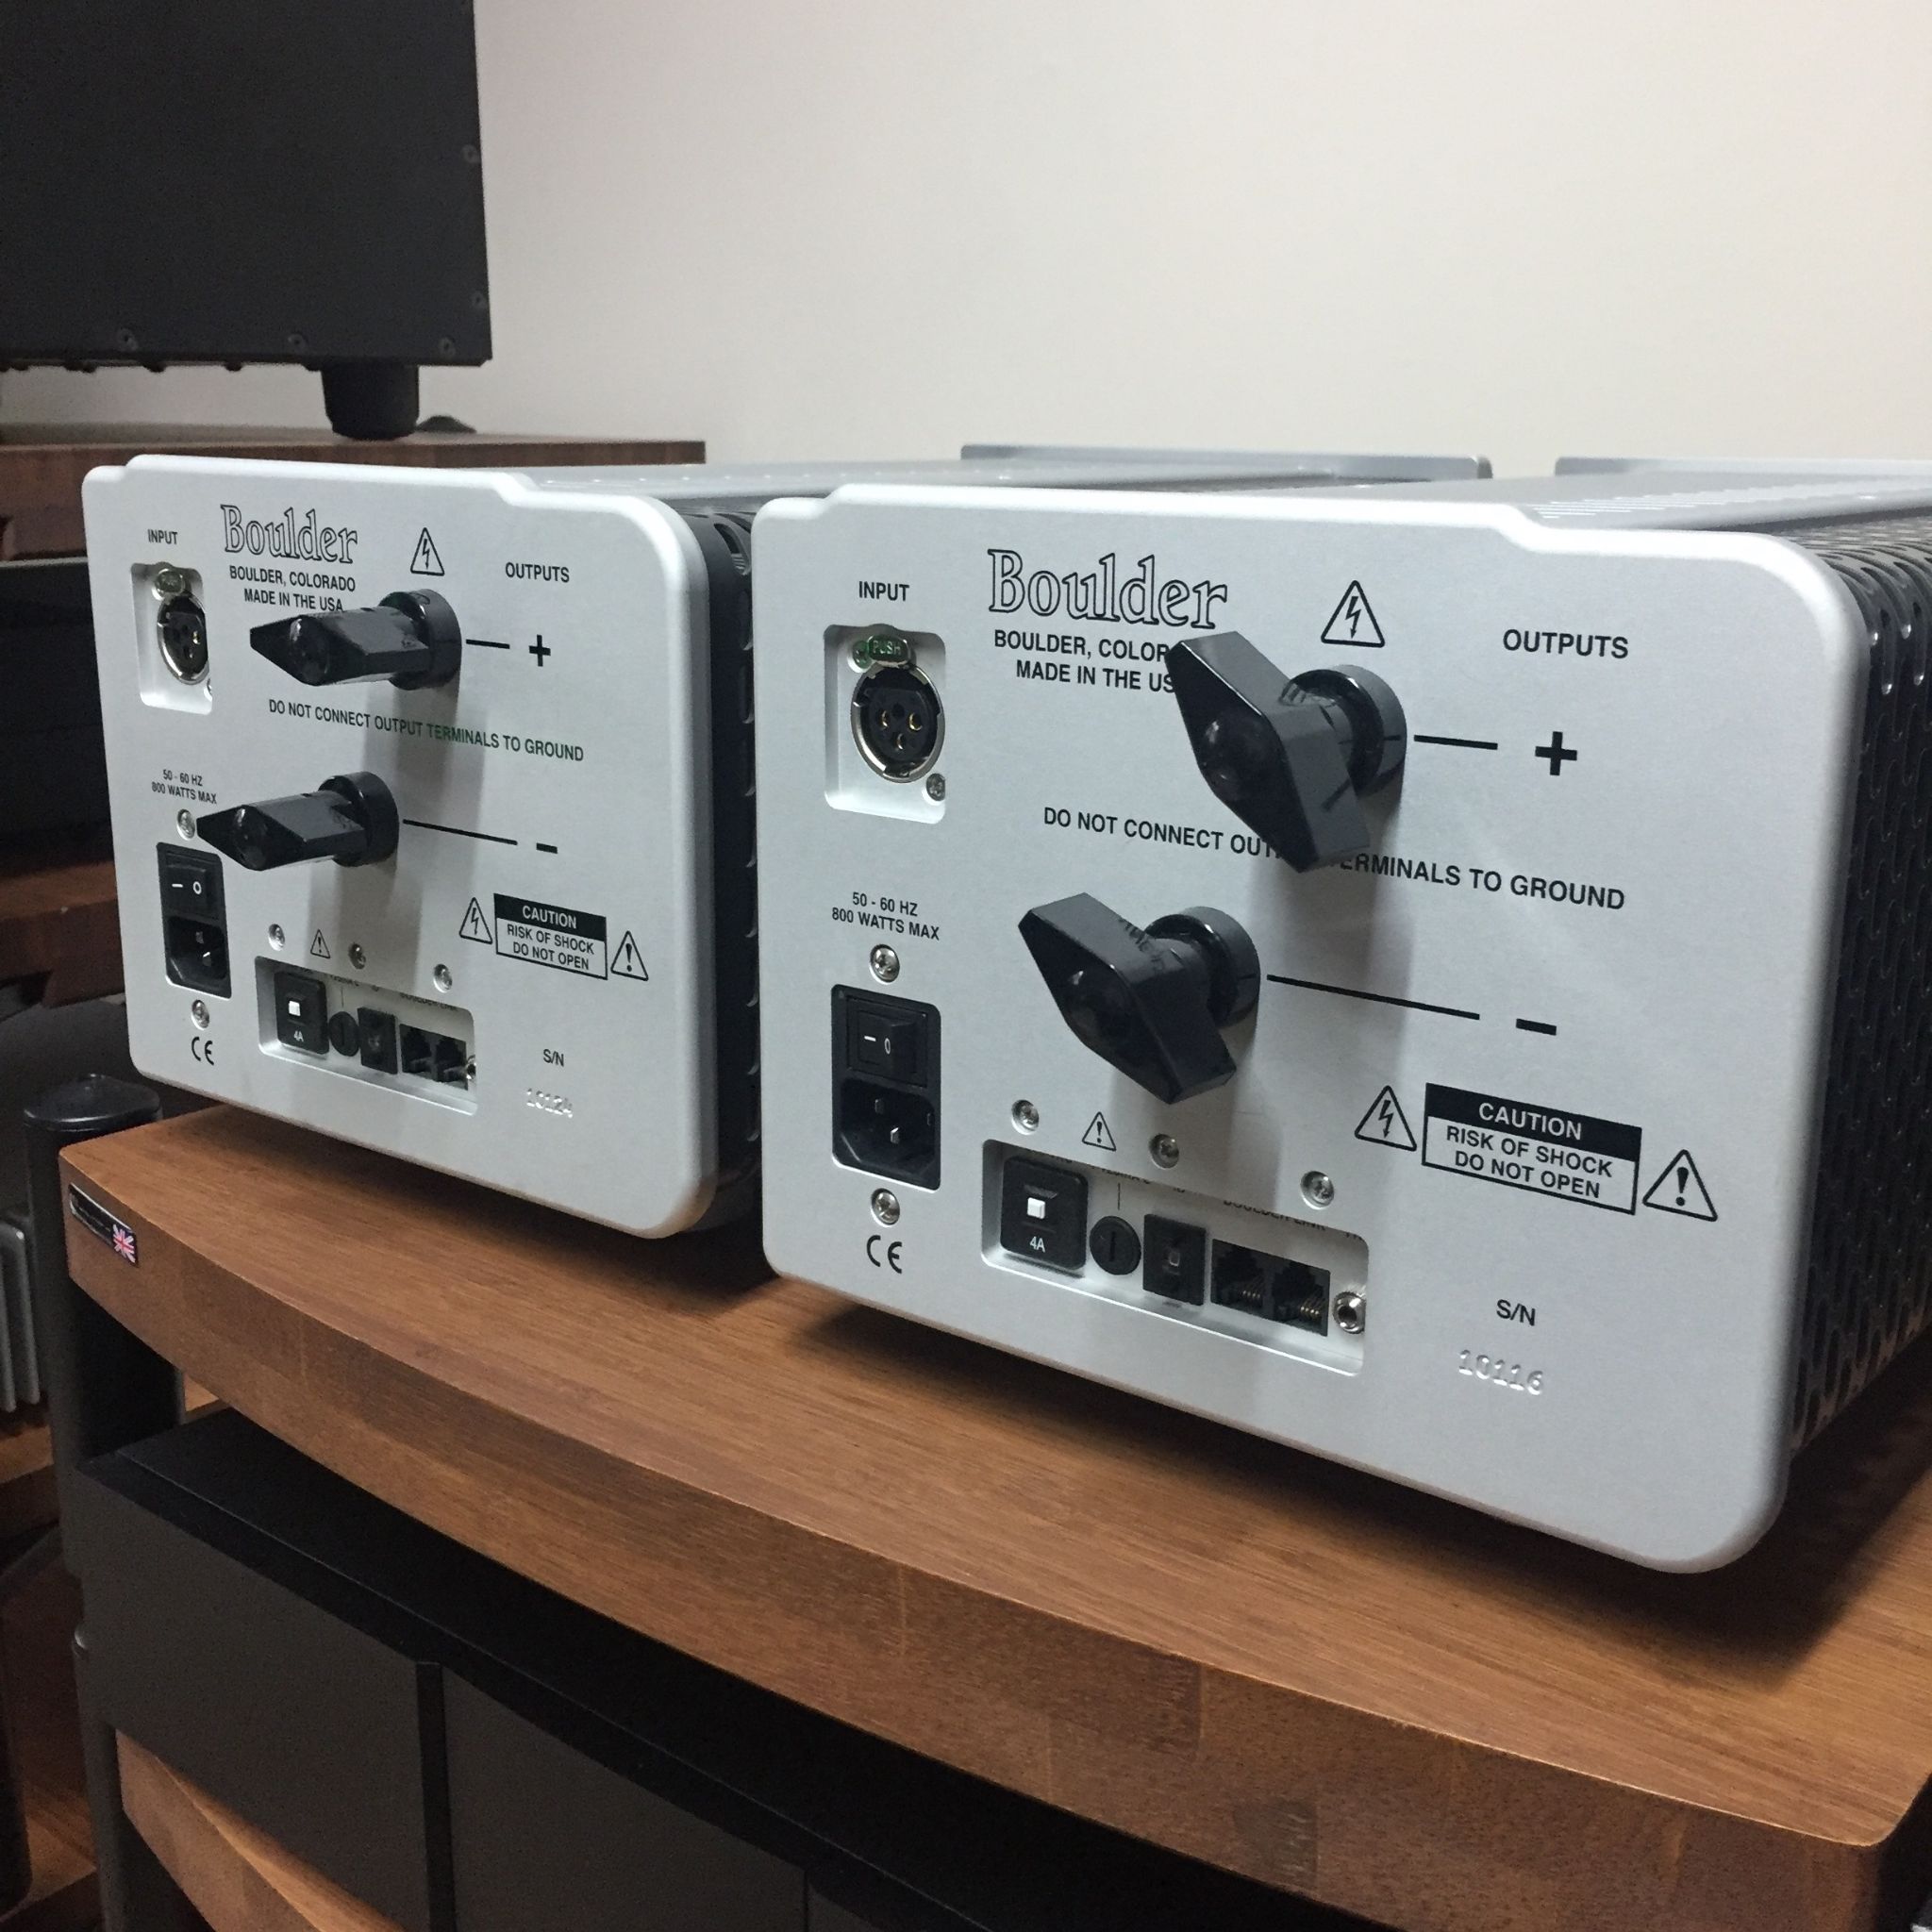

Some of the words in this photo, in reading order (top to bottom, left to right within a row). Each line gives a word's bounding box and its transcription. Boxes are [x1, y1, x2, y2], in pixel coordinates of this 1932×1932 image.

[147, 529, 178, 545] INPUT
[221, 504, 358, 564] Boulder
[229, 565, 287, 587] BOULDER,
[289, 572, 356, 591] COLORADO
[506, 561, 570, 583] OUTPUTS
[243, 589, 275, 605] MADE
[279, 593, 291, 607] IN
[293, 593, 316, 609] THE
[319, 597, 343, 612] USA
[858, 581, 910, 602] INPUT
[988, 548, 1227, 629] Boulder
[994, 629, 1091, 659] BOULDER,
[1098, 639, 1170, 662] COLOR
[1503, 629, 1629, 658] OUTPUTS
[1016, 660, 1071, 682] MADE
[1077, 666, 1095, 685] IN
[1103, 668, 1141, 690] THE
[1149, 673, 1176, 693] US
[269, 699, 285, 714] DO
[289, 702, 311, 718] NOT
[315, 707, 370, 728] CONNECT
[375, 716, 423, 737] OUTPUT
[426, 724, 500, 748] TERMINALS
[503, 735, 521, 752] TO
[525, 739, 584, 761] GROUND
[162, 769, 173, 781] 50
[179, 773, 190, 784] 60
[192, 774, 203, 787] HZ
[152, 781, 166, 794] 800
[168, 784, 196, 800] WATTS
[198, 791, 217, 805] MAX
[1043, 807, 1071, 827] DO
[1078, 812, 1118, 834] NOT
[1124, 819, 1224, 850] CONNECT
[1469, 868, 1502, 891] TO
[1510, 874, 1624, 910] GROUND
[522, 905, 577, 929] CAUTION
[852, 891, 867, 907] 50
[880, 897, 895, 912] 60
[900, 901, 918, 917] HZ
[832, 907, 854, 924] 800
[858, 911, 905, 934] WATTS
[908, 922, 940, 941] MAX
[507, 924, 533, 941] RISK
[536, 930, 551, 944] OF
[554, 934, 594, 955] SHOCK
[513, 941, 529, 956] DO
[532, 946, 555, 961] NOT
[558, 954, 590, 970] OPEN
[192, 1036, 214, 1066] CE
[543, 1048, 564, 1067] S/N
[1478, 1102, 1582, 1141] CAUTION
[1446, 1125, 1494, 1151] RISK
[1501, 1138, 1529, 1158] OF
[1536, 1145, 1613, 1178] SHOCK
[1455, 1150, 1484, 1171] DO
[1491, 1158, 1534, 1183] NOT
[1541, 1170, 1600, 1198] OPEN
[866, 1234, 903, 1274] CE
[1029, 1236, 1045, 1253] 4A
[1496, 1299, 1536, 1326] S/N
[1458, 1349, 1544, 1396] 10116
